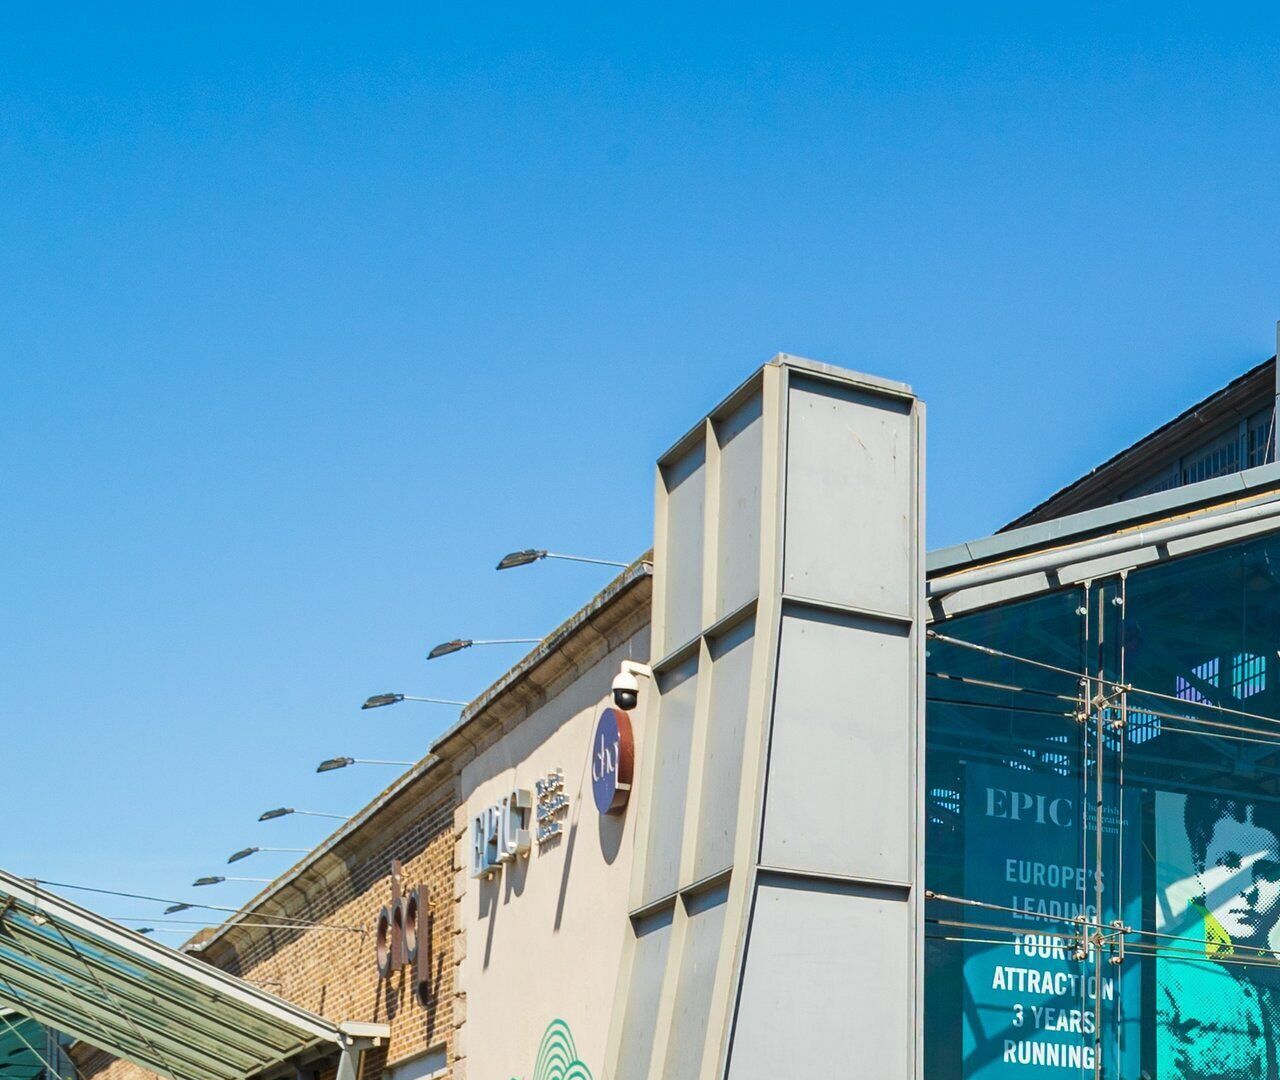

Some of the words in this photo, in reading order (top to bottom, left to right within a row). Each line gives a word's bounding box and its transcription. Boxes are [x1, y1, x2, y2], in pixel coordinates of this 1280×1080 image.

[985, 787, 1072, 827] EPIC
[1012, 896, 1098, 927] LEADING
[1012, 932, 1097, 963] TOURIT
[992, 966, 1114, 1001] ATTRACTION
[1012, 1003, 1024, 1028] 3
[1031, 1005, 1096, 1034] YEARS
